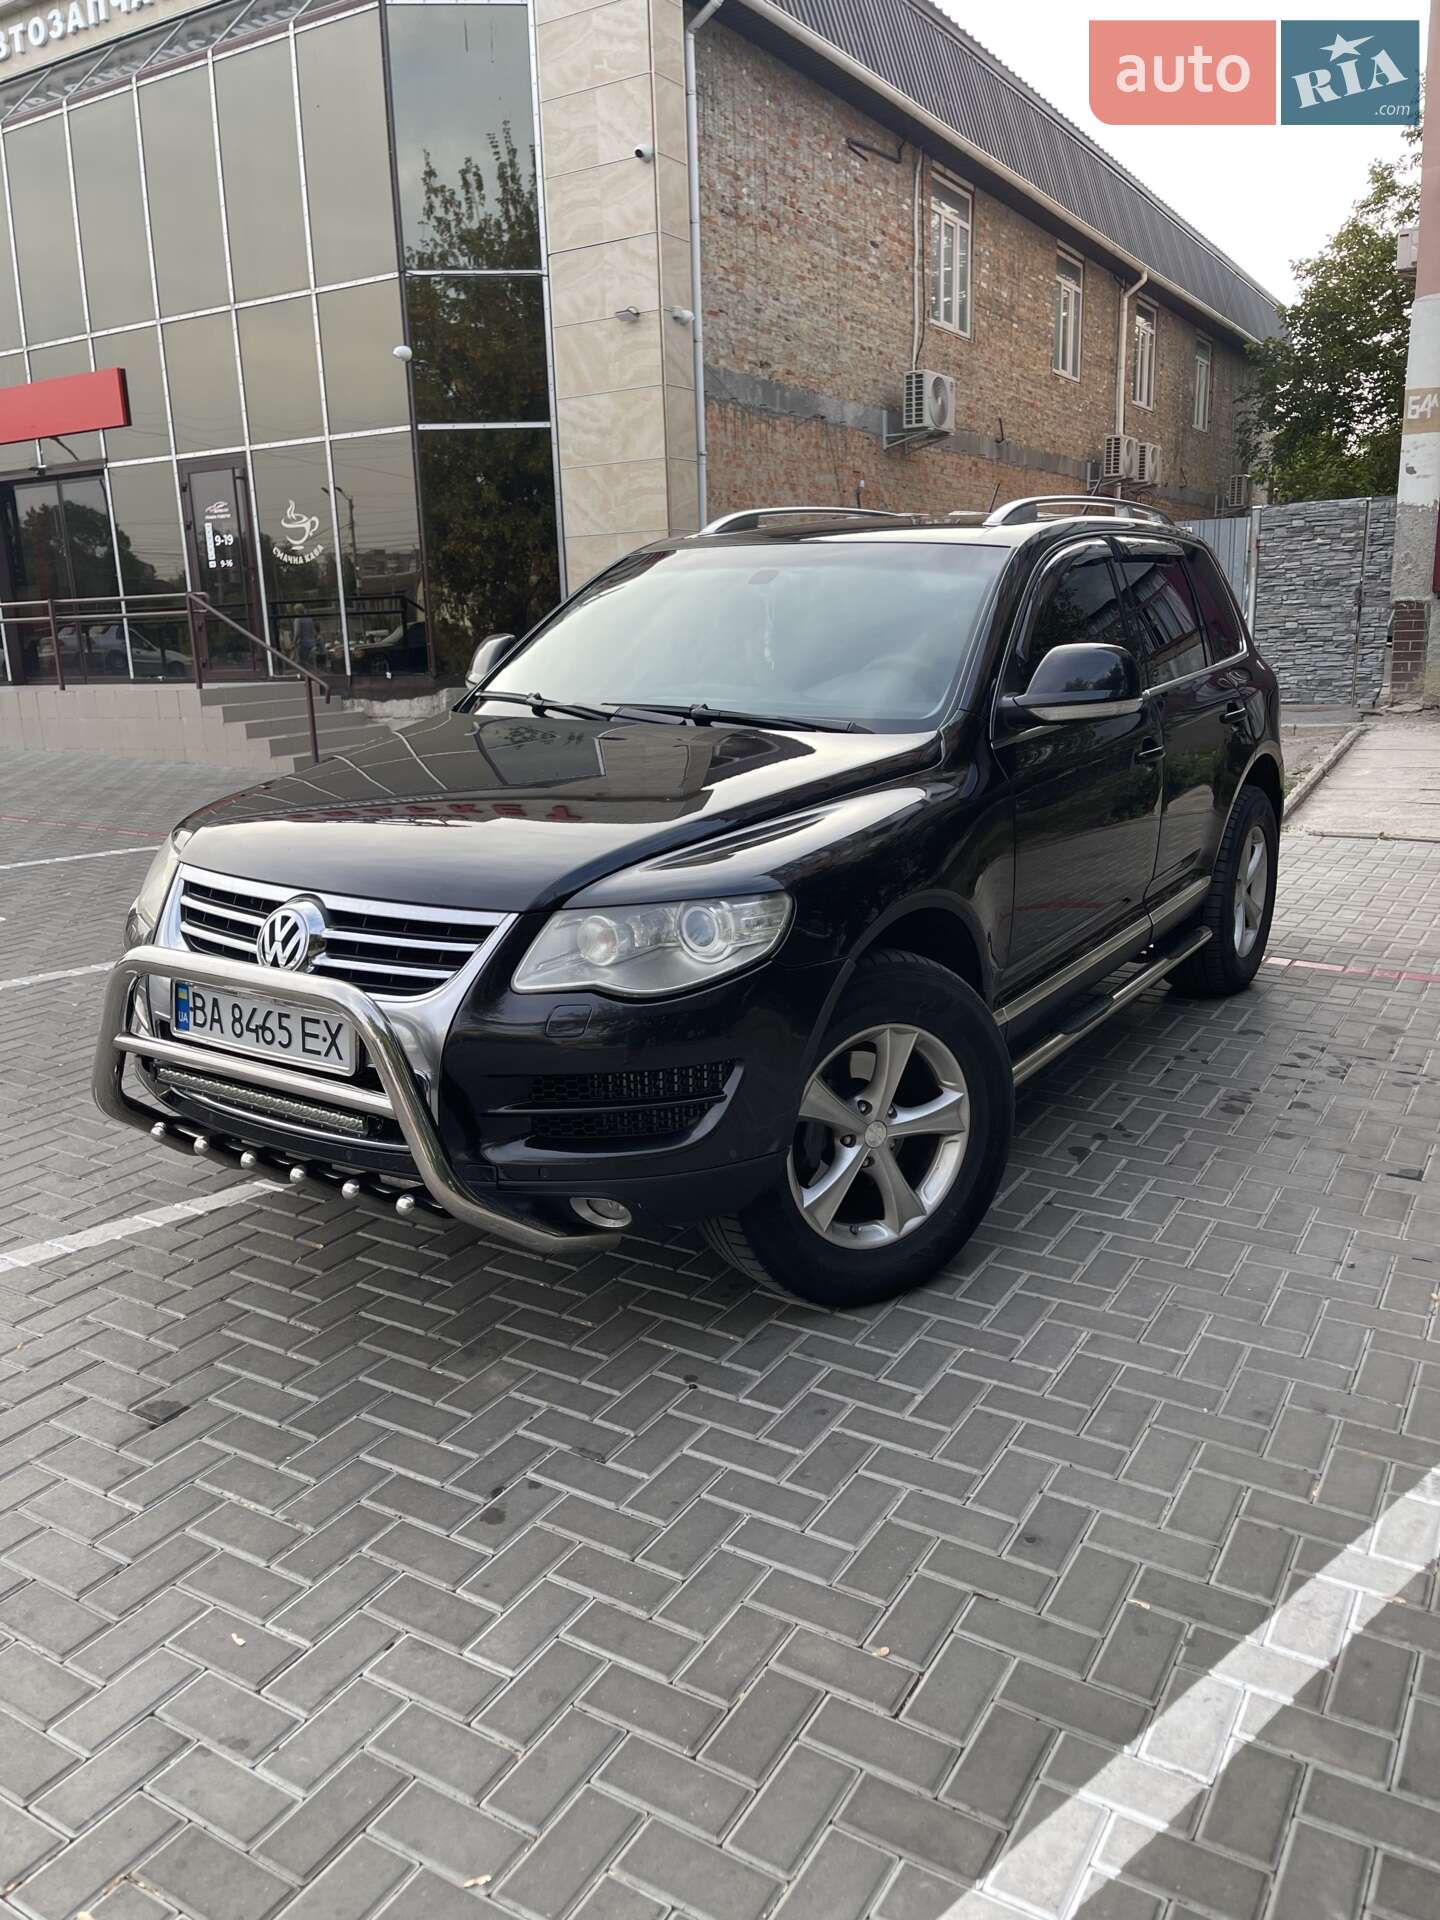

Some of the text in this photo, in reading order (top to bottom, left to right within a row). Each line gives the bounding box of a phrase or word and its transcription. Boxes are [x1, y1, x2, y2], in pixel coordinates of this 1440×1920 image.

[214, 534, 234, 546] 9-19
[178, 1010, 189, 1024] UA
[192, 991, 344, 1061] BA 8465 EX
